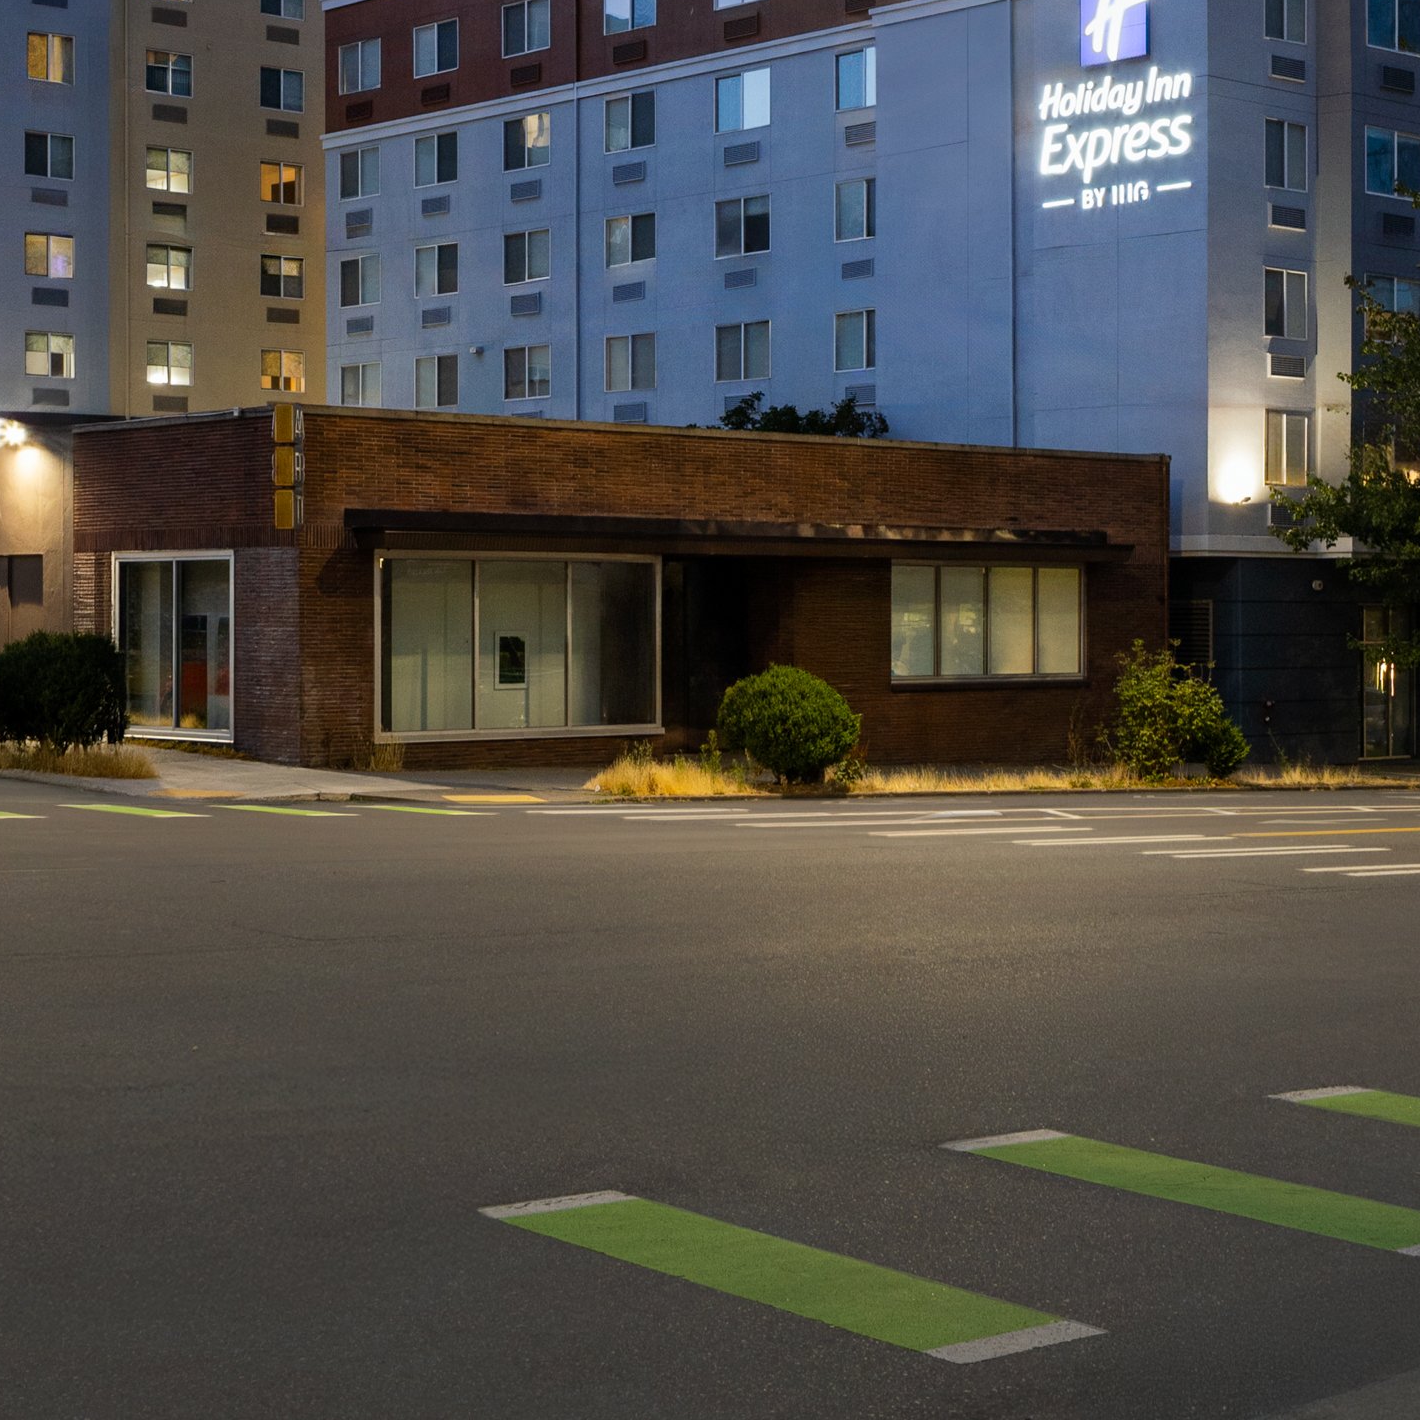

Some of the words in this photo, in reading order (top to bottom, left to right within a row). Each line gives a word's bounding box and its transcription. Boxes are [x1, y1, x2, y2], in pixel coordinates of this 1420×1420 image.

[1039, 76, 1143, 121] Holiday
[1146, 66, 1192, 104] Inn
[1039, 115, 1192, 184] Express
[1082, 187, 1106, 209] BY
